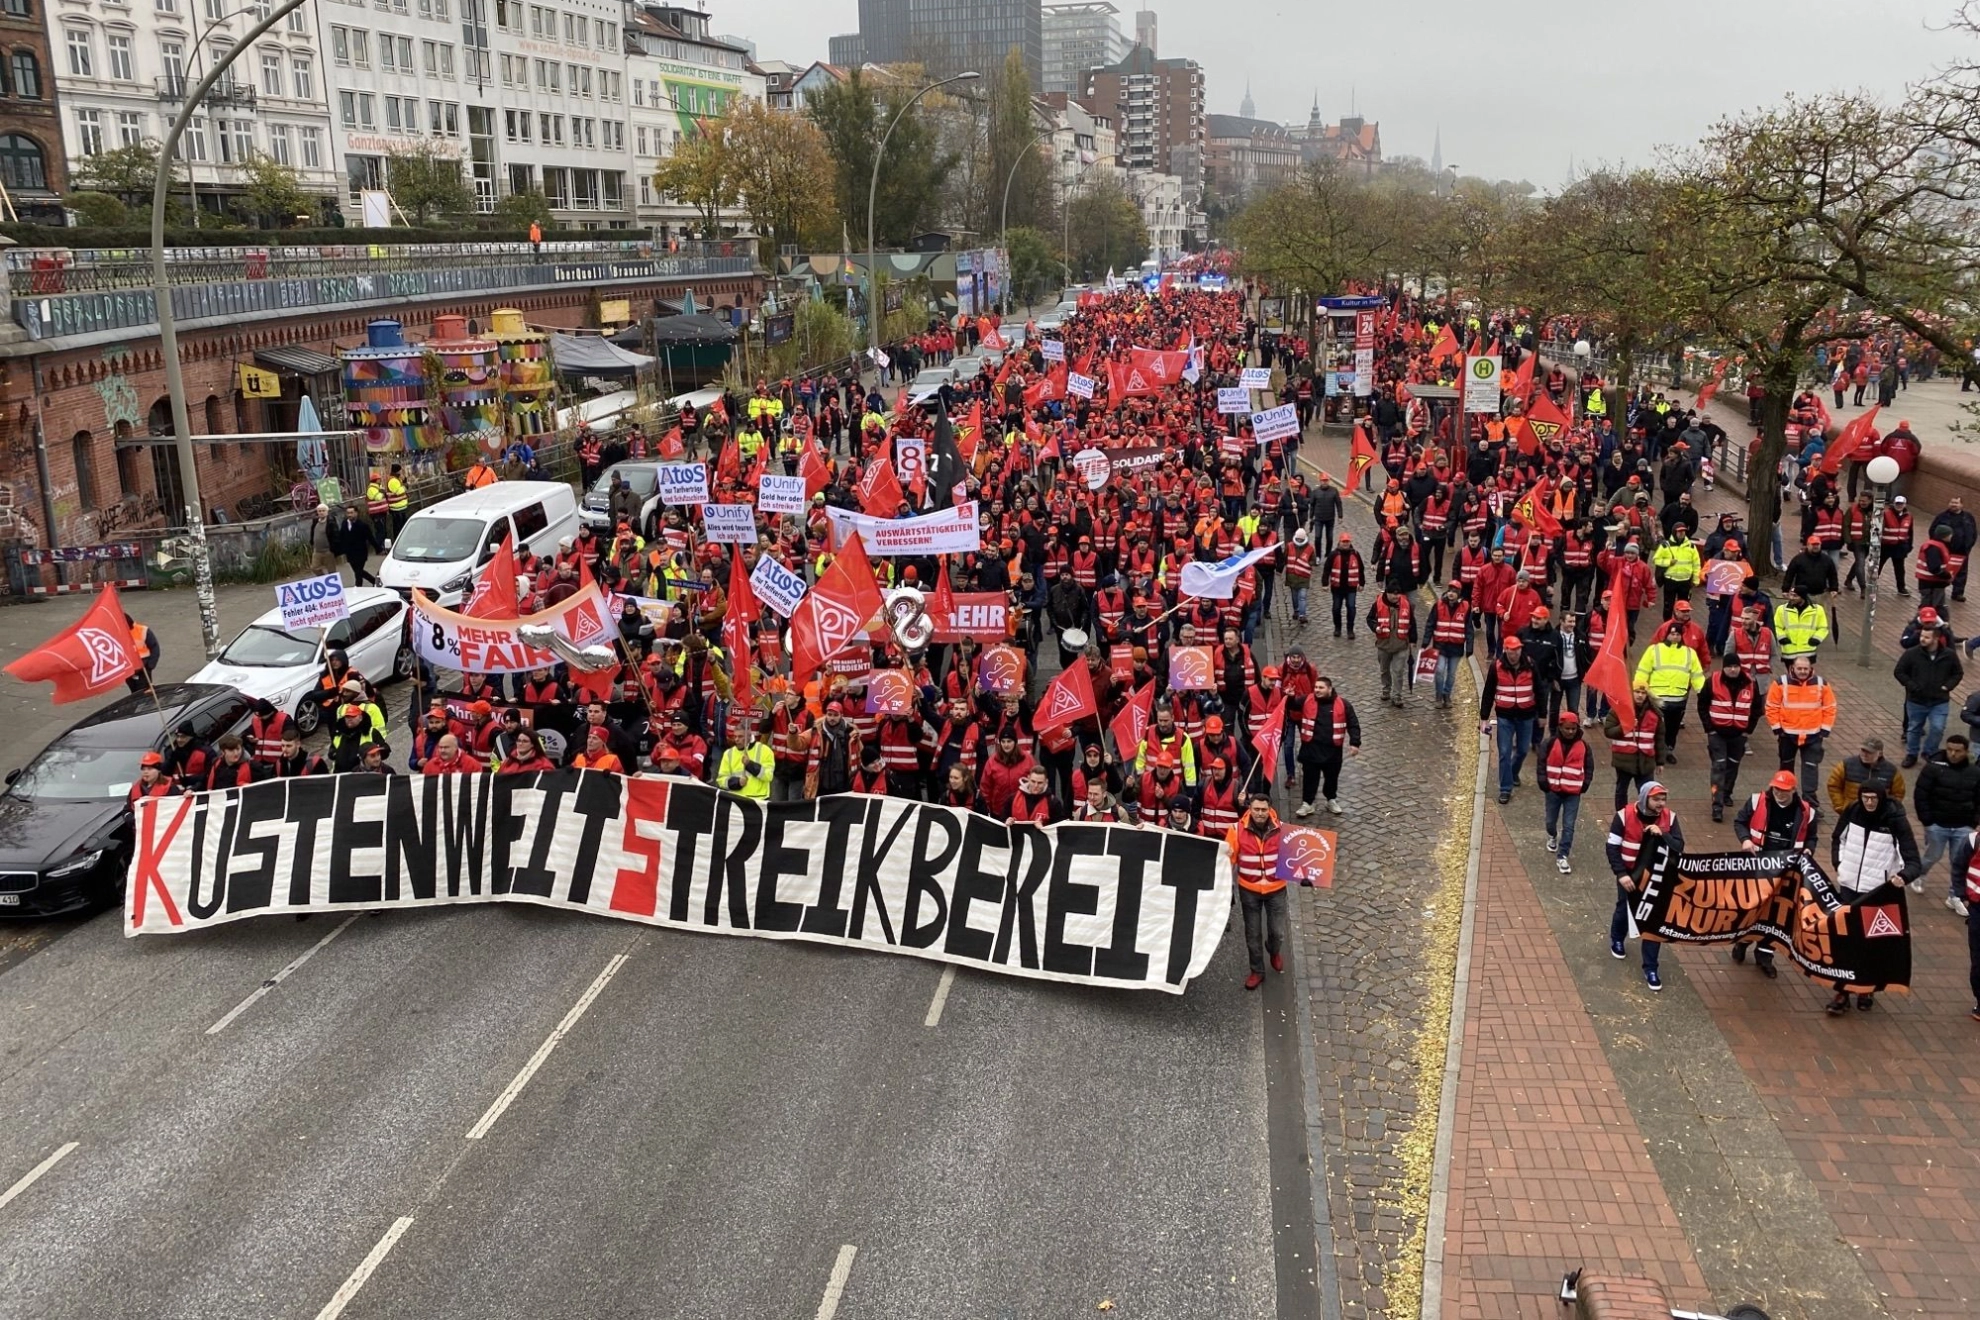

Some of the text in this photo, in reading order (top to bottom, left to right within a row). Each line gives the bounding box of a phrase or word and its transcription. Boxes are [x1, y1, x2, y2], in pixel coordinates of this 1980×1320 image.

[1226, 388, 1248, 398] Unify
[1264, 407, 1294, 421] Unify
[901, 446, 922, 471] 8
[660, 465, 706, 485] Atos
[773, 478, 804, 493] Unify
[716, 507, 750, 521] Unify
[875, 523, 973, 538] AUSWÄRTSTÄTIGKEITEN
[876, 537, 933, 547] VERBESSERN!
[756, 557, 805, 599] Atos
[281, 574, 342, 608] Atos
[763, 580, 792, 606] Tarifverträge
[283, 599, 345, 618] Fehler 404: Konzept
[290, 617, 307, 628] nicht
[307, 611, 336, 626] gefunden
[432, 622, 461, 656] 8 %
[457, 625, 512, 644] MEHR
[459, 640, 557, 670] FAIR
[833, 662, 871, 672] VERDIENT!
[1635, 845, 1669, 921] STILL
[1677, 857, 1711, 872] JUNGE
[1712, 857, 1785, 872] GENERATION:
[1807, 872, 1829, 892] BEI
[1665, 893, 1738, 934] NUR
